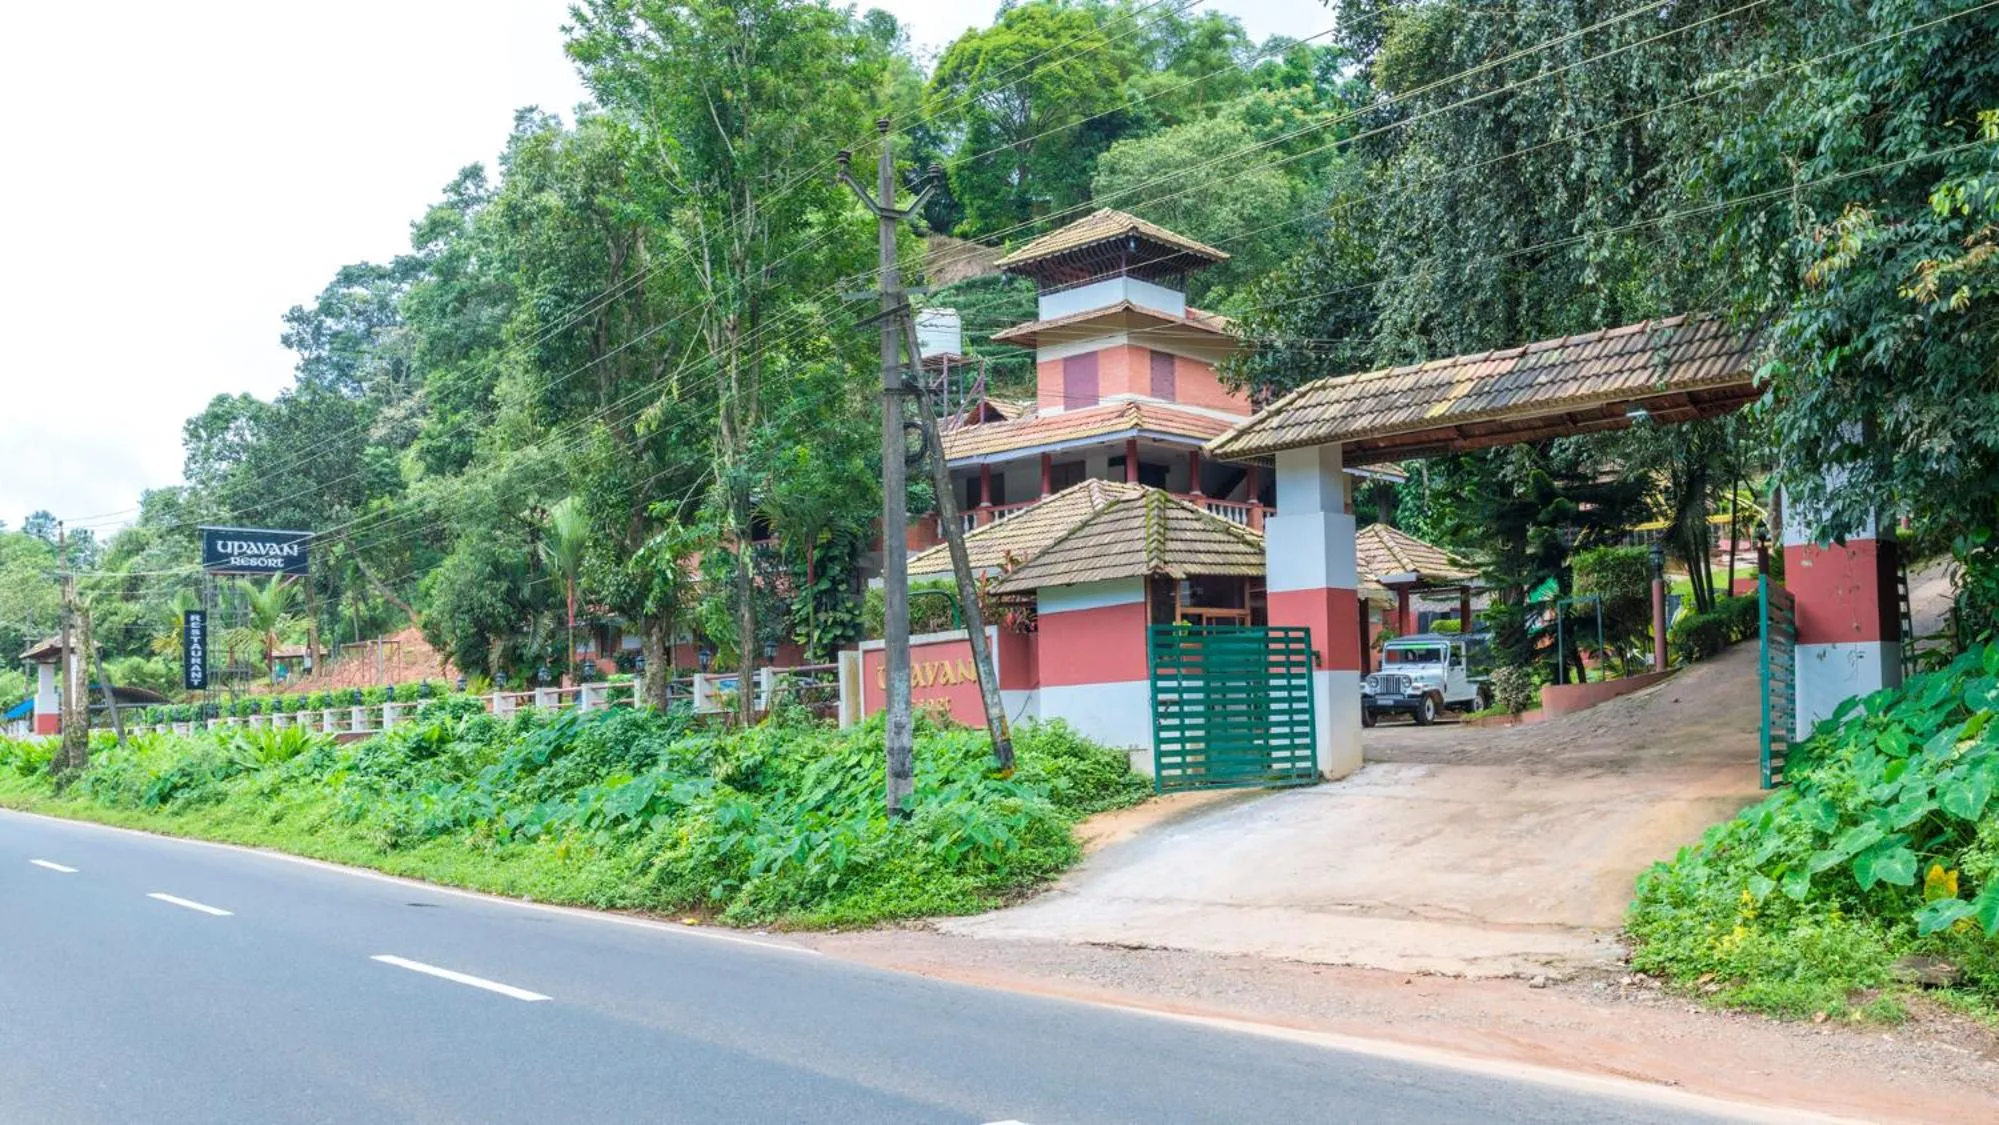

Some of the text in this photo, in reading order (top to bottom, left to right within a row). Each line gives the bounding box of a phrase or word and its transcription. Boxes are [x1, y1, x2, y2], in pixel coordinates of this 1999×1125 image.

[216, 540, 298, 557] UPAVAN
[230, 556, 284, 568] RESORT
[190, 614, 202, 686] RESTAURANT
